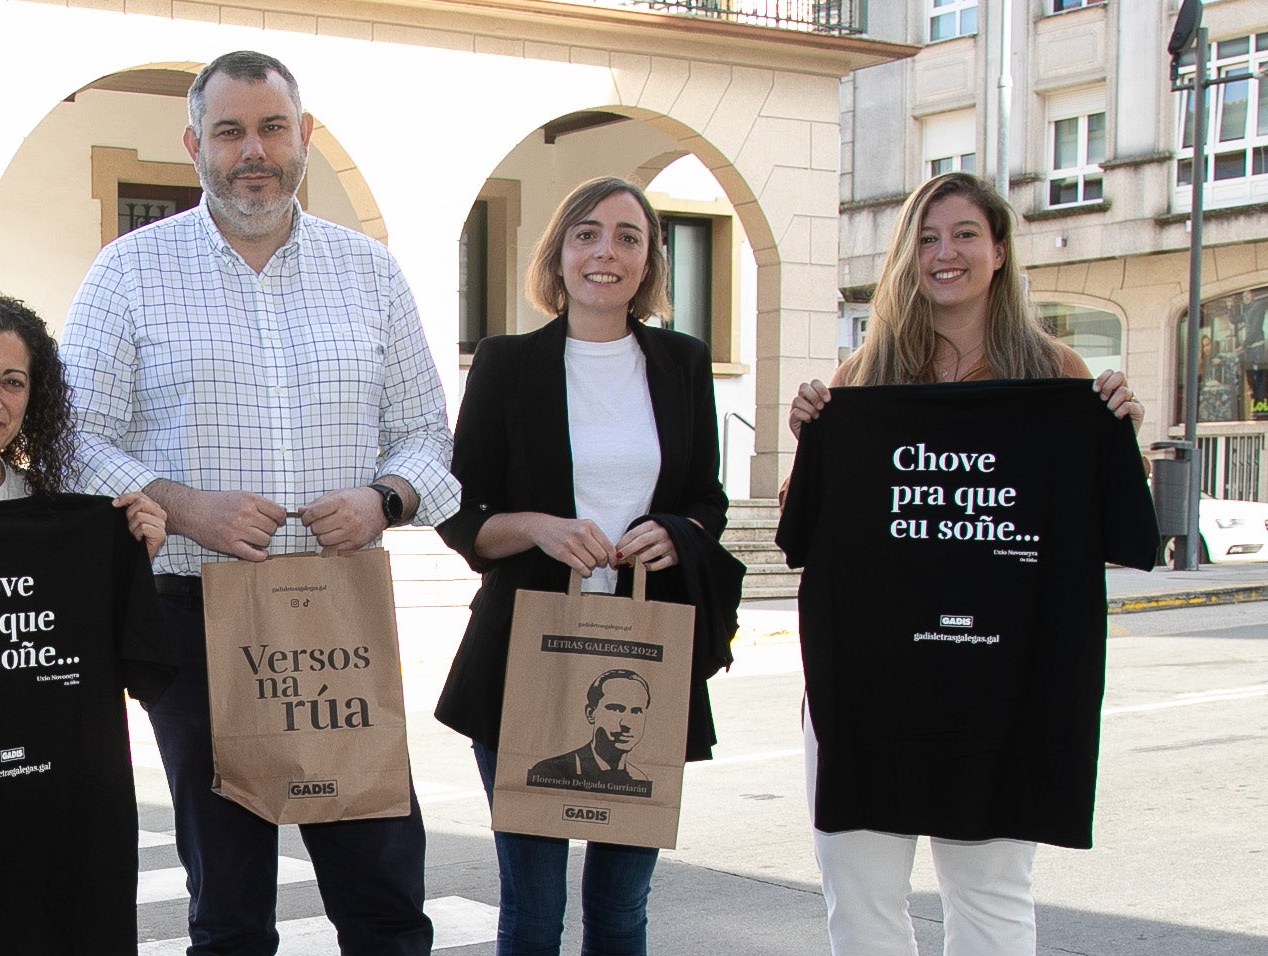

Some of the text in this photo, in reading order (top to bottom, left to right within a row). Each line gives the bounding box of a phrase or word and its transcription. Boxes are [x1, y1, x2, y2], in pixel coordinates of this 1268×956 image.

[893, 443, 995, 472] Chove
[891, 486, 1016, 514] pra que
[891, 516, 1039, 541] eu soñe...
[0, 611, 54, 643] que
[942, 617, 972, 625] GADIS
[547, 639, 658, 657] LETRAS GALEGAS 2022
[913, 632, 1000, 644] gadisletrasgalegas.gal
[239, 645, 370, 677] Versos
[255, 674, 303, 699] na
[281, 684, 374, 731] rúa
[2, 750, 23, 760] GADIS
[290, 784, 336, 796] GADIS
[532, 775, 647, 794] Florencio Delgado Gurriarán
[565, 808, 608, 822] GADIS
